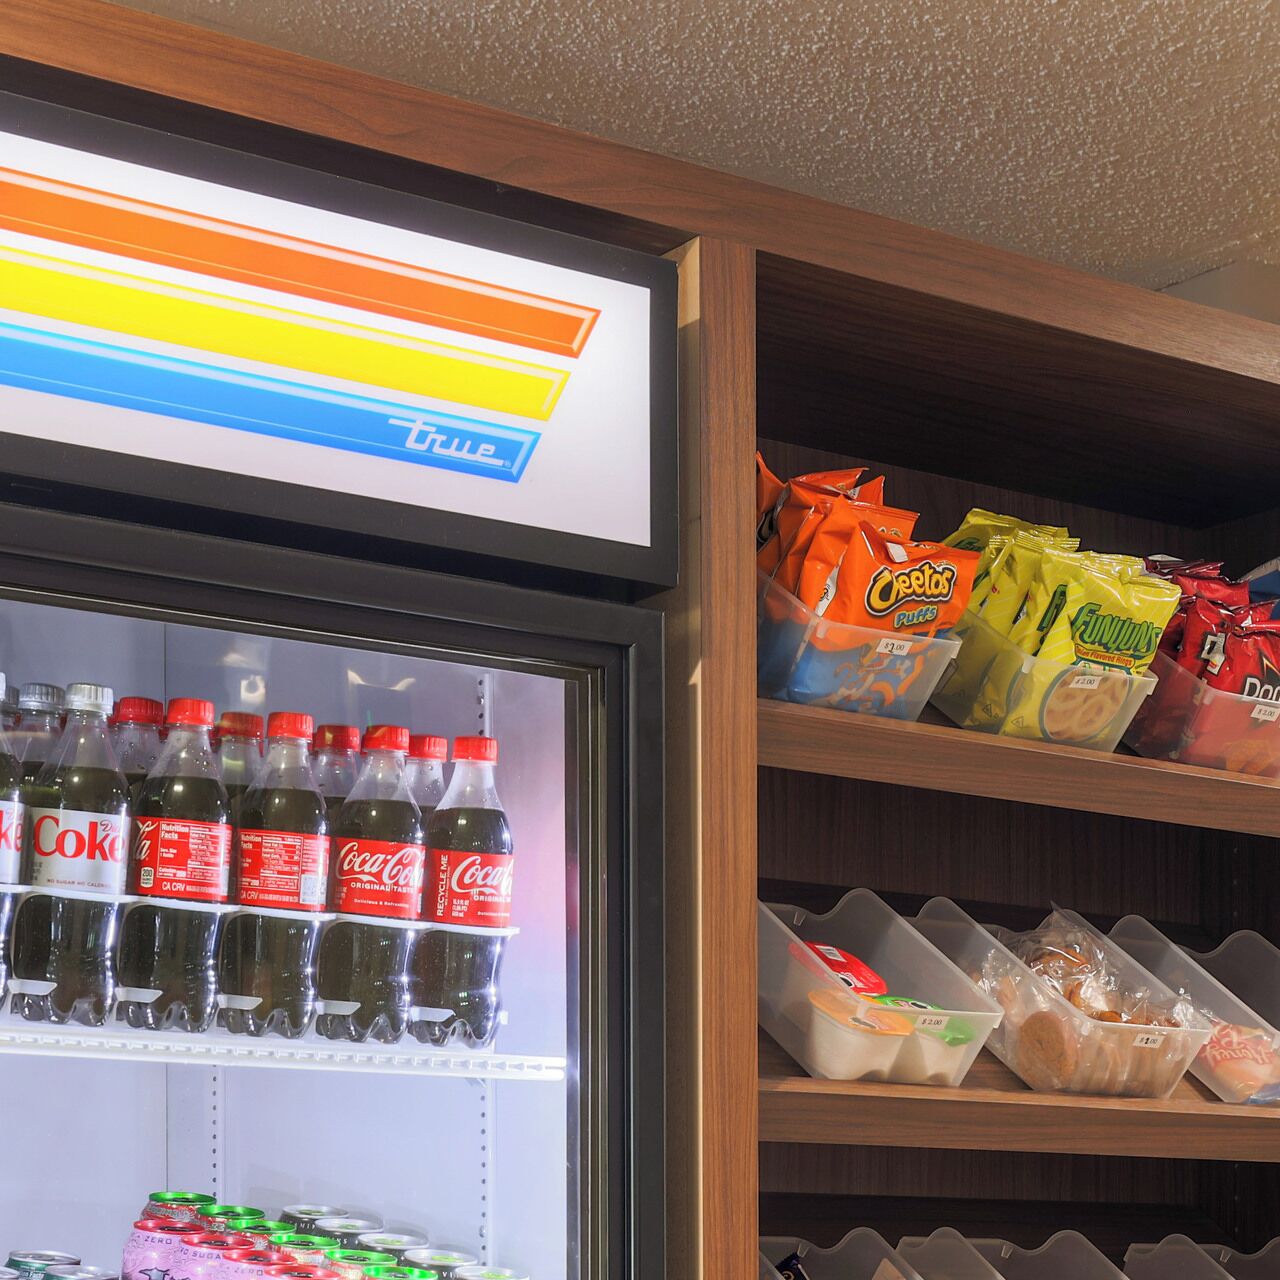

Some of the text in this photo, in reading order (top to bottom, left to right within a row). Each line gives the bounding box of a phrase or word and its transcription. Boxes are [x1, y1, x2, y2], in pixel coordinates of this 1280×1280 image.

[388, 419, 504, 466] true
[866, 561, 956, 615] Cheetos
[894, 605, 938, 628] Puffs
[436, 854, 449, 916] RECYCLE ME
